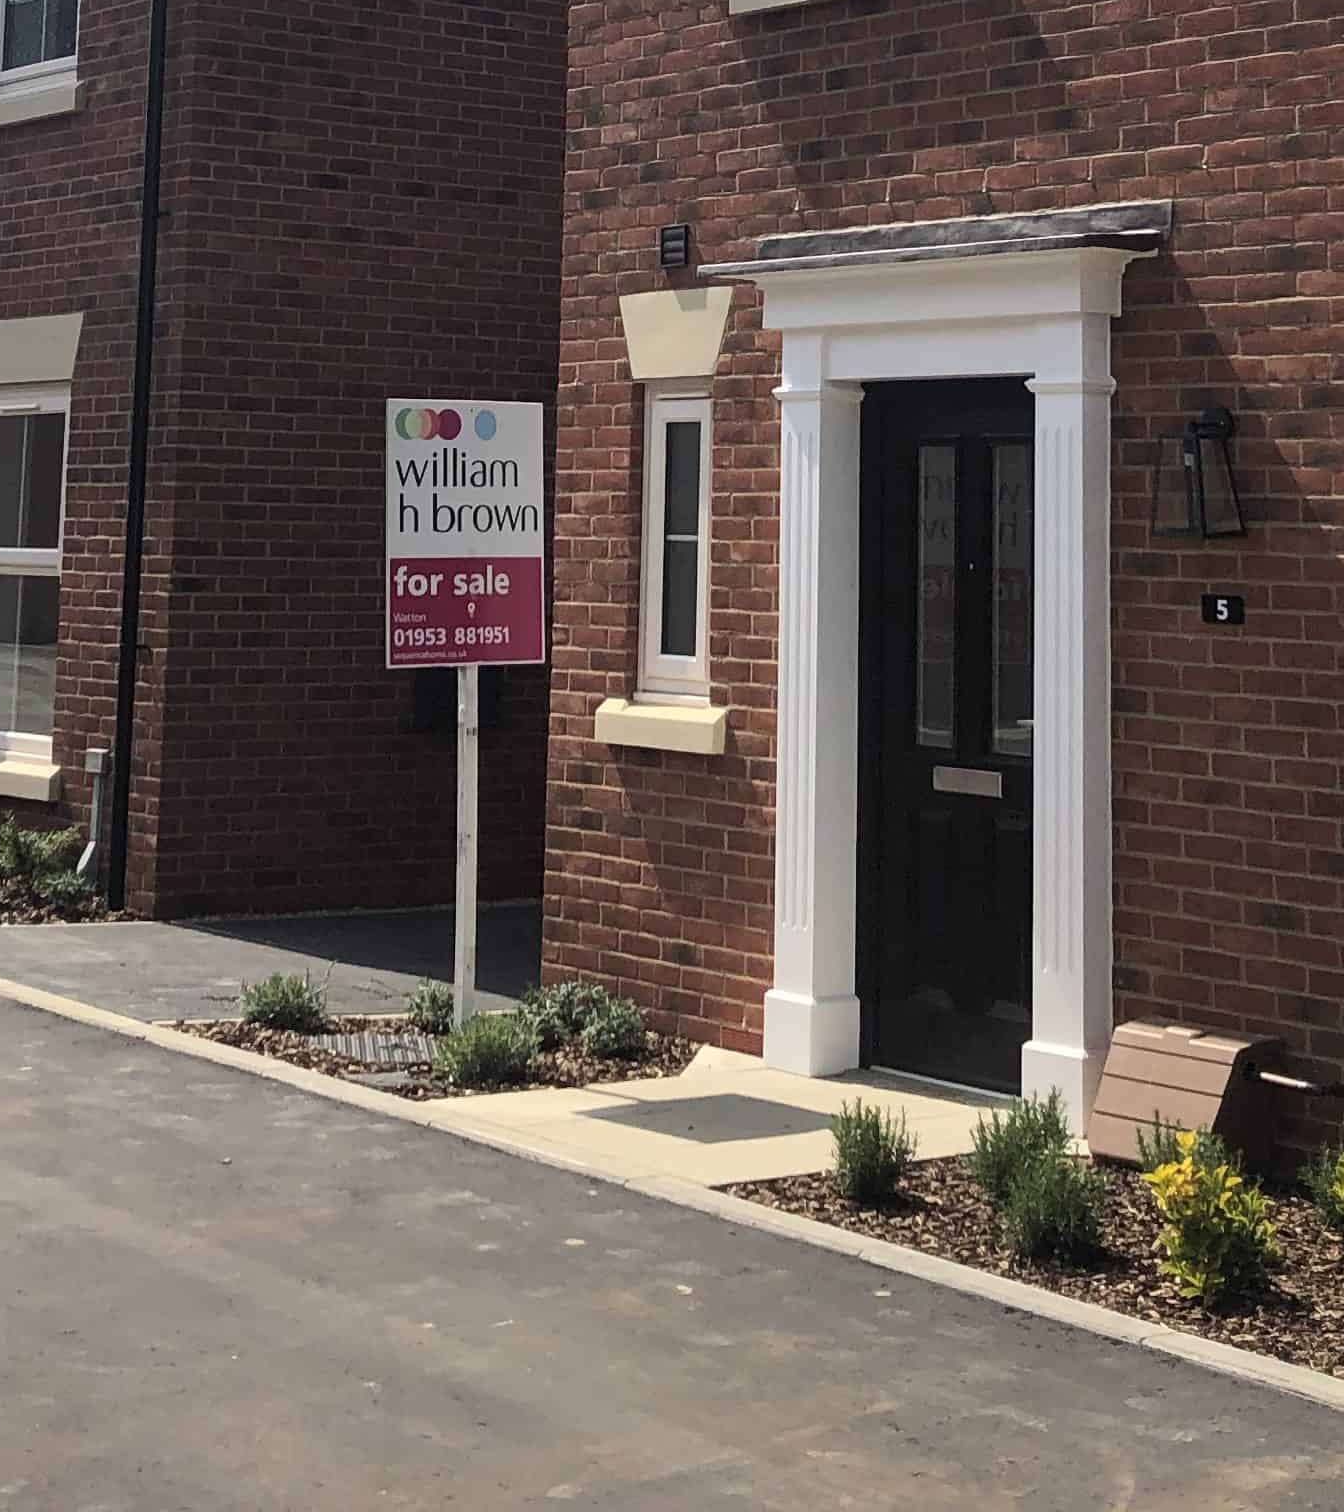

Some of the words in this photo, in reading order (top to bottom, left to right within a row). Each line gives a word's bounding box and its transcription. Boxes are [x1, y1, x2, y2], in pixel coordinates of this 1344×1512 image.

[395, 448, 518, 488] william
[399, 493, 419, 533] h
[432, 493, 538, 533] brown
[393, 565, 444, 597] for
[453, 564, 510, 596] sale
[1216, 599, 1229, 621] 5
[394, 627, 447, 647] 01953
[454, 626, 510, 645] 881951
